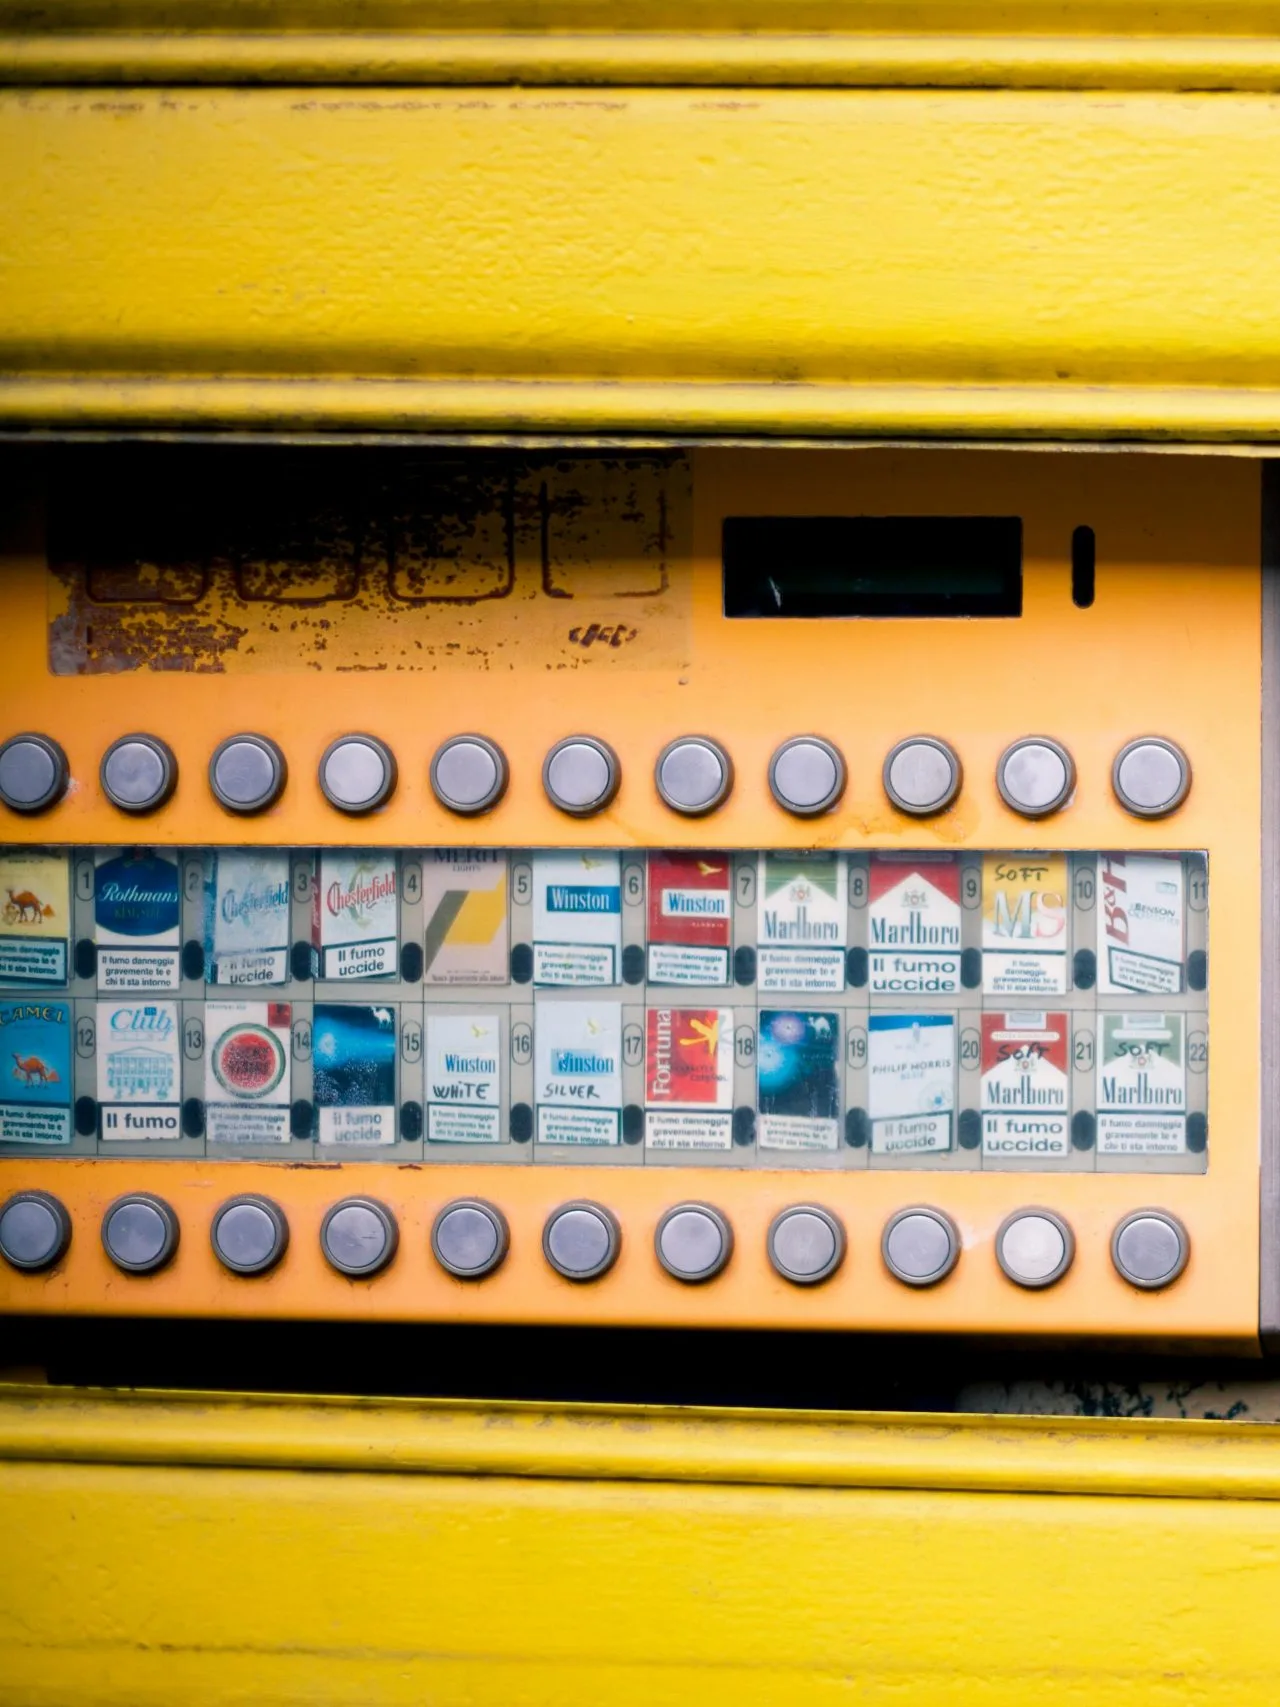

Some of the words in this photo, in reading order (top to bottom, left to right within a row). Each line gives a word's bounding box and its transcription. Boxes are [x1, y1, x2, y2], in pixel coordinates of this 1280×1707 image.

[83, 871, 90, 889] 1
[189, 872, 200, 890] 2
[994, 864, 1049, 882] SOFT
[297, 874, 307, 891] 3
[408, 875, 417, 892] 4
[517, 875, 527, 893] 5
[628, 876, 639, 894] 6
[741, 877, 751, 895] 7
[853, 879, 863, 896] 8
[966, 879, 977, 897] 9
[1077, 881, 1092, 899] 10
[1192, 882, 1206, 899] 11
[102, 882, 179, 902] Rothmans
[326, 872, 396, 917] Chesterfield
[551, 887, 610, 910] Winston
[667, 892, 725, 914] Winston
[1134, 903, 1176, 917] BENSON
[765, 906, 839, 940] Marlboro
[992, 891, 1065, 939] MS
[871, 911, 960, 945] Marlboro
[0, 956, 40, 965] ravemente
[338, 950, 346, 963] Il
[350, 947, 385, 961] fumo
[339, 960, 385, 976] uccide
[873, 958, 884, 972] Il
[894, 957, 956, 973] fumo
[230, 969, 273, 983] uccide
[873, 977, 955, 991] uccide
[110, 1008, 173, 1036] Club
[79, 1030, 94, 1047] 12
[186, 1031, 202, 1048] 13
[295, 1032, 310, 1048] 14
[404, 1035, 420, 1051] 15
[514, 1036, 530, 1052] 16
[625, 1036, 640, 1054] 17
[738, 1038, 753, 1055] 18
[653, 1009, 672, 1095] Fortuna
[850, 1040, 865, 1057] 19
[962, 1040, 979, 1059] 20
[1076, 1042, 1092, 1060] 21
[1114, 1041, 1171, 1057] SOFT
[1190, 1043, 1206, 1061] 22
[445, 1053, 496, 1073] Winston
[557, 1052, 614, 1073] Winston
[872, 1063, 908, 1074] PHILIP
[911, 1060, 952, 1071] MORRIS
[543, 1083, 600, 1099] SILVER
[987, 1075, 1064, 1105] Marlboro
[1103, 1072, 1182, 1105] Marlboro
[107, 1113, 117, 1128] Il
[124, 1113, 177, 1129] fumo
[346, 1112, 382, 1125] fumo
[987, 1120, 998, 1133] Il
[1006, 1120, 1063, 1133] fumo
[334, 1128, 381, 1140] uccide
[898, 1121, 937, 1135] fumo
[885, 1135, 936, 1151] uccide
[987, 1139, 1063, 1152] uccide
